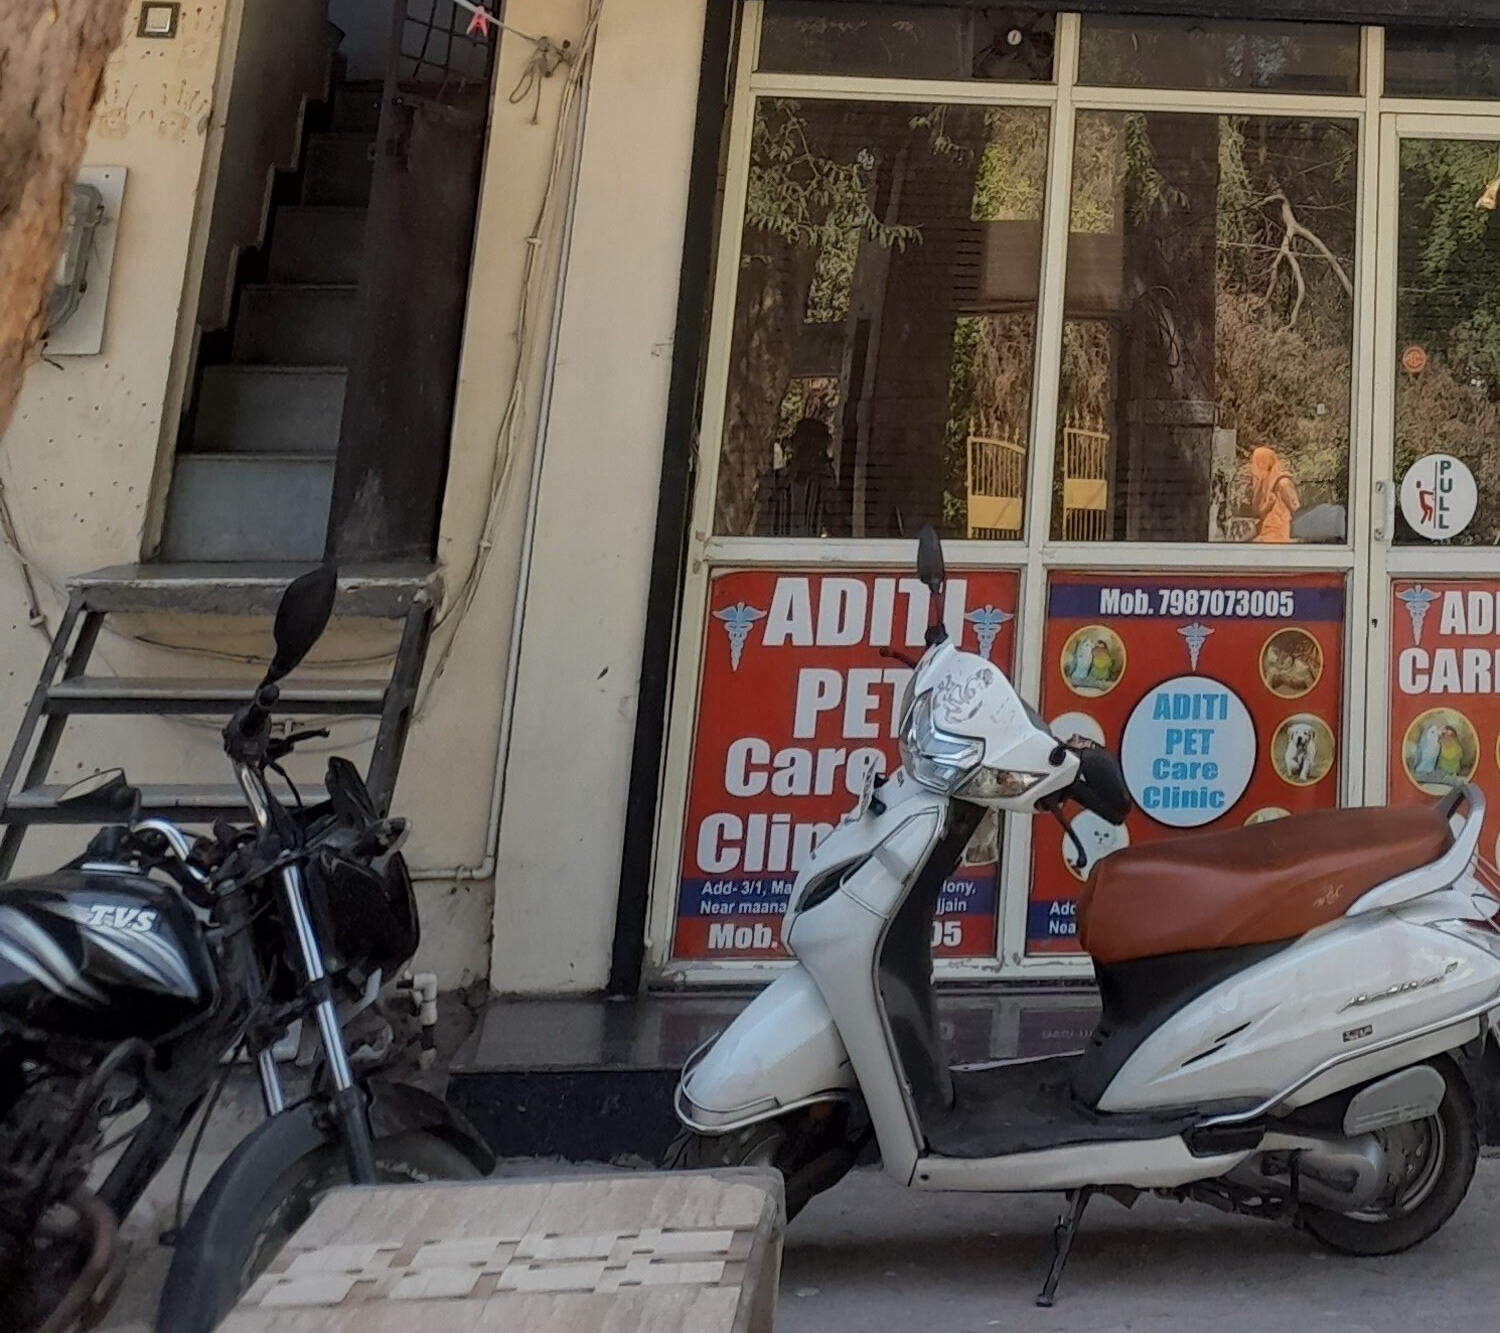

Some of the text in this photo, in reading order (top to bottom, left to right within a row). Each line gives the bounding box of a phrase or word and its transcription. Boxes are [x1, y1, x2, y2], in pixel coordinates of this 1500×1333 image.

[1439, 459, 1454, 530] PULL
[762, 577, 967, 647] ADITI
[1100, 588, 1296, 618] Mob. 7987073005
[1153, 693, 1229, 721] ADITI
[1165, 728, 1215, 756] PET
[724, 737, 887, 798] Care
[1152, 757, 1219, 781] Care
[1142, 786, 1226, 810] Clinic
[90, 904, 157, 932] TVS
[699, 900, 736, 915] Near
[708, 923, 778, 950] Mob.
